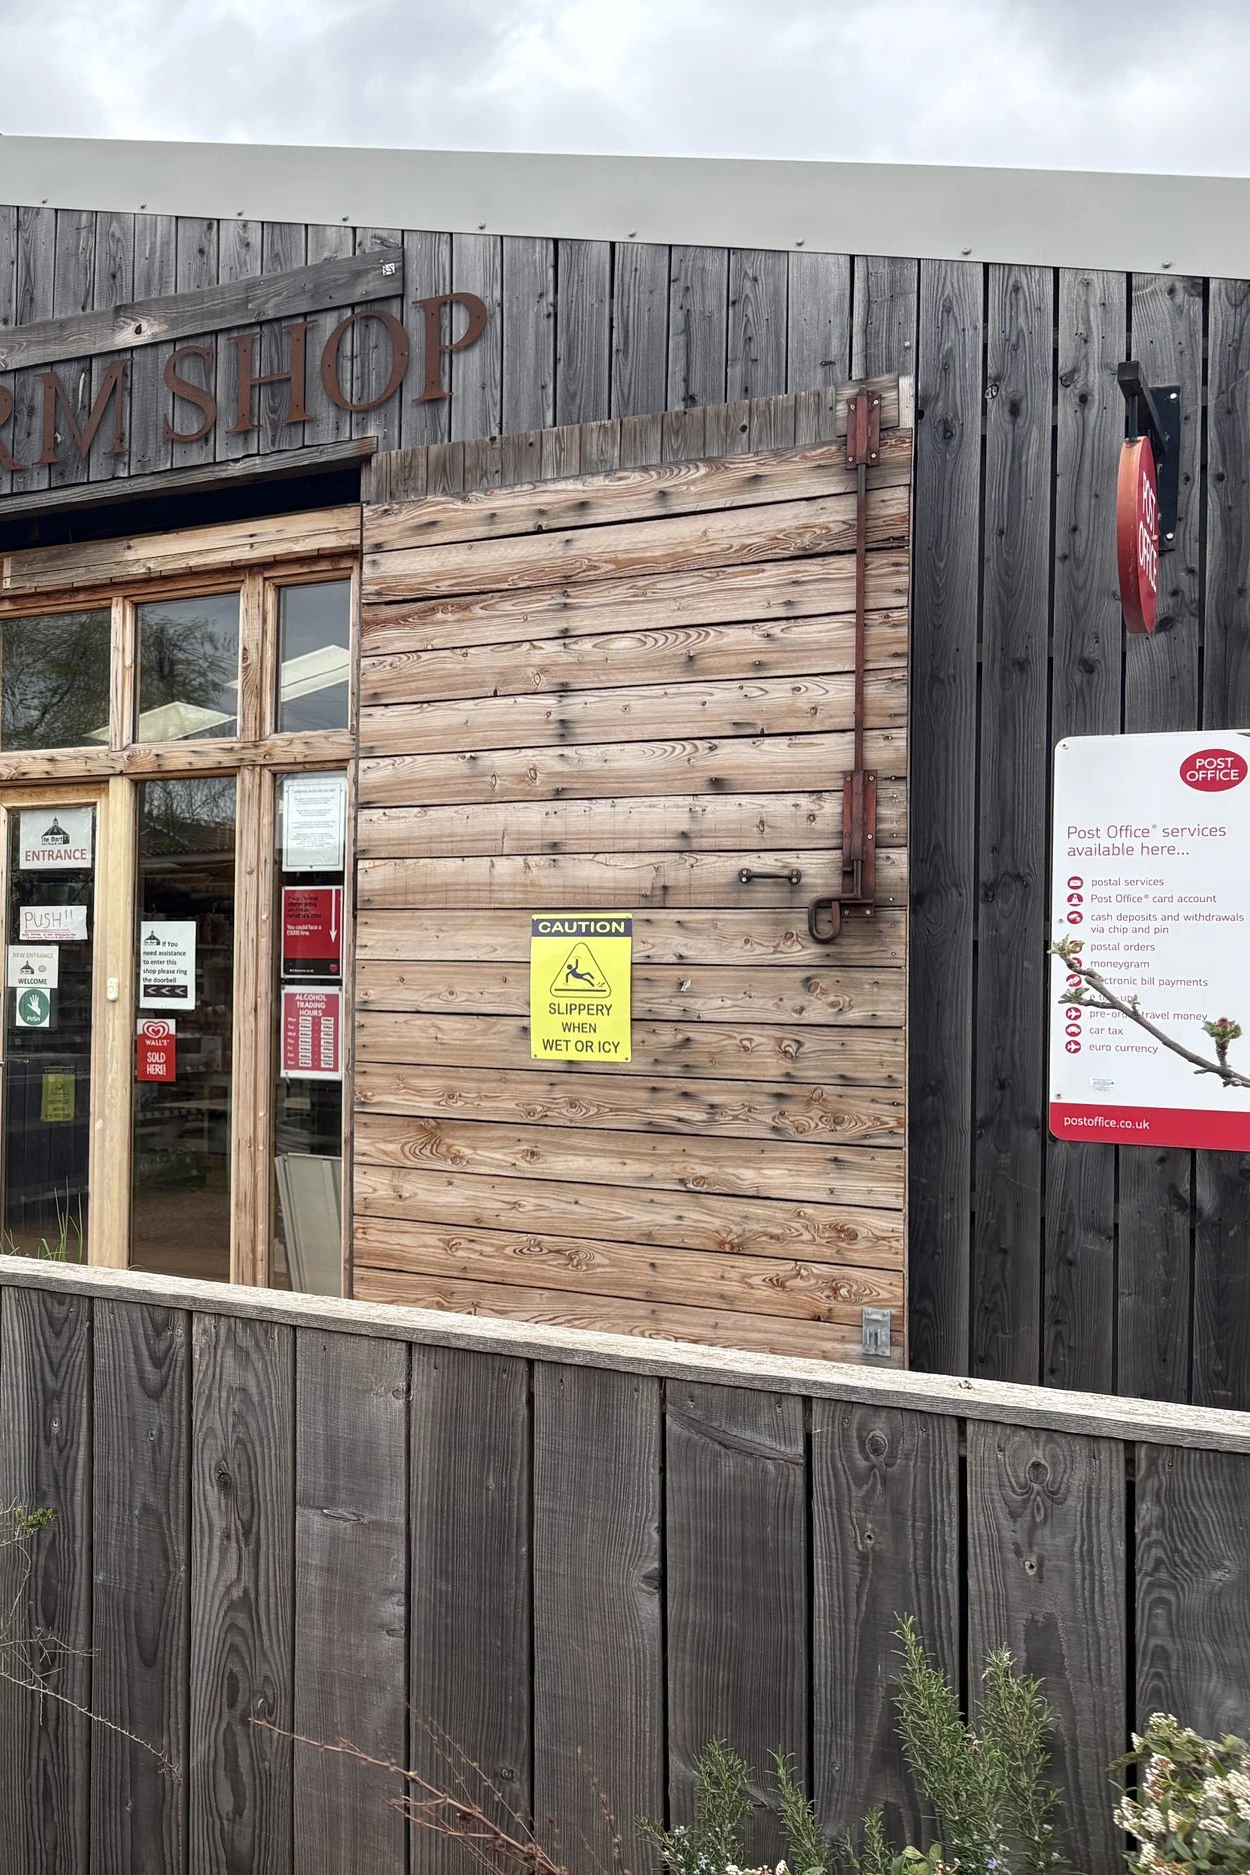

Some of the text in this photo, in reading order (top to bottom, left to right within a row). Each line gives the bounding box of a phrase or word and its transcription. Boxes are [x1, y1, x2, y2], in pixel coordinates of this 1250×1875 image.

[162, 291, 488, 442] SHOP
[1142, 470, 1155, 536] POST
[1138, 520, 1157, 593] OFFICE
[1195, 757, 1234, 769] POST
[1186, 769, 1239, 782] OFFICE
[1067, 826, 1101, 839] Post
[1162, 824, 1227, 838] services
[25, 848, 87, 861] ENTRANCE
[1067, 843, 1190, 857] available here...
[1091, 877, 1164, 887] postal services
[1090, 894, 1113, 903] Post
[1152, 894, 1174, 903] card
[1177, 894, 1217, 903] account
[24, 908, 73, 929] PUSH!!
[1090, 911, 1244, 924] cash deposits and withdrawals
[537, 921, 625, 934] CAUTION
[1090, 924, 1169, 936] via chip and pin
[1090, 942, 1156, 953] postal orders
[157, 967, 176, 975] please
[1090, 961, 1150, 970] moneygram
[1141, 976, 1155, 986] bill
[1158, 976, 1208, 988] payments
[296, 1001, 326, 1009] TRADING
[548, 1002, 613, 1017] SLIPPERY
[299, 1008, 323, 1017] HOURS
[1141, 1010, 1170, 1020] travel
[1173, 1013, 1208, 1022] money
[561, 1022, 597, 1034] WHEN
[1089, 1025, 1123, 1035] car tax
[542, 1038, 620, 1054] WET OR ICY
[1089, 1044, 1158, 1054] euro currency
[146, 1051, 166, 1063] SOLD
[146, 1063, 167, 1075] HERE!
[1064, 1116, 1149, 1129] postoffice.co.uk
